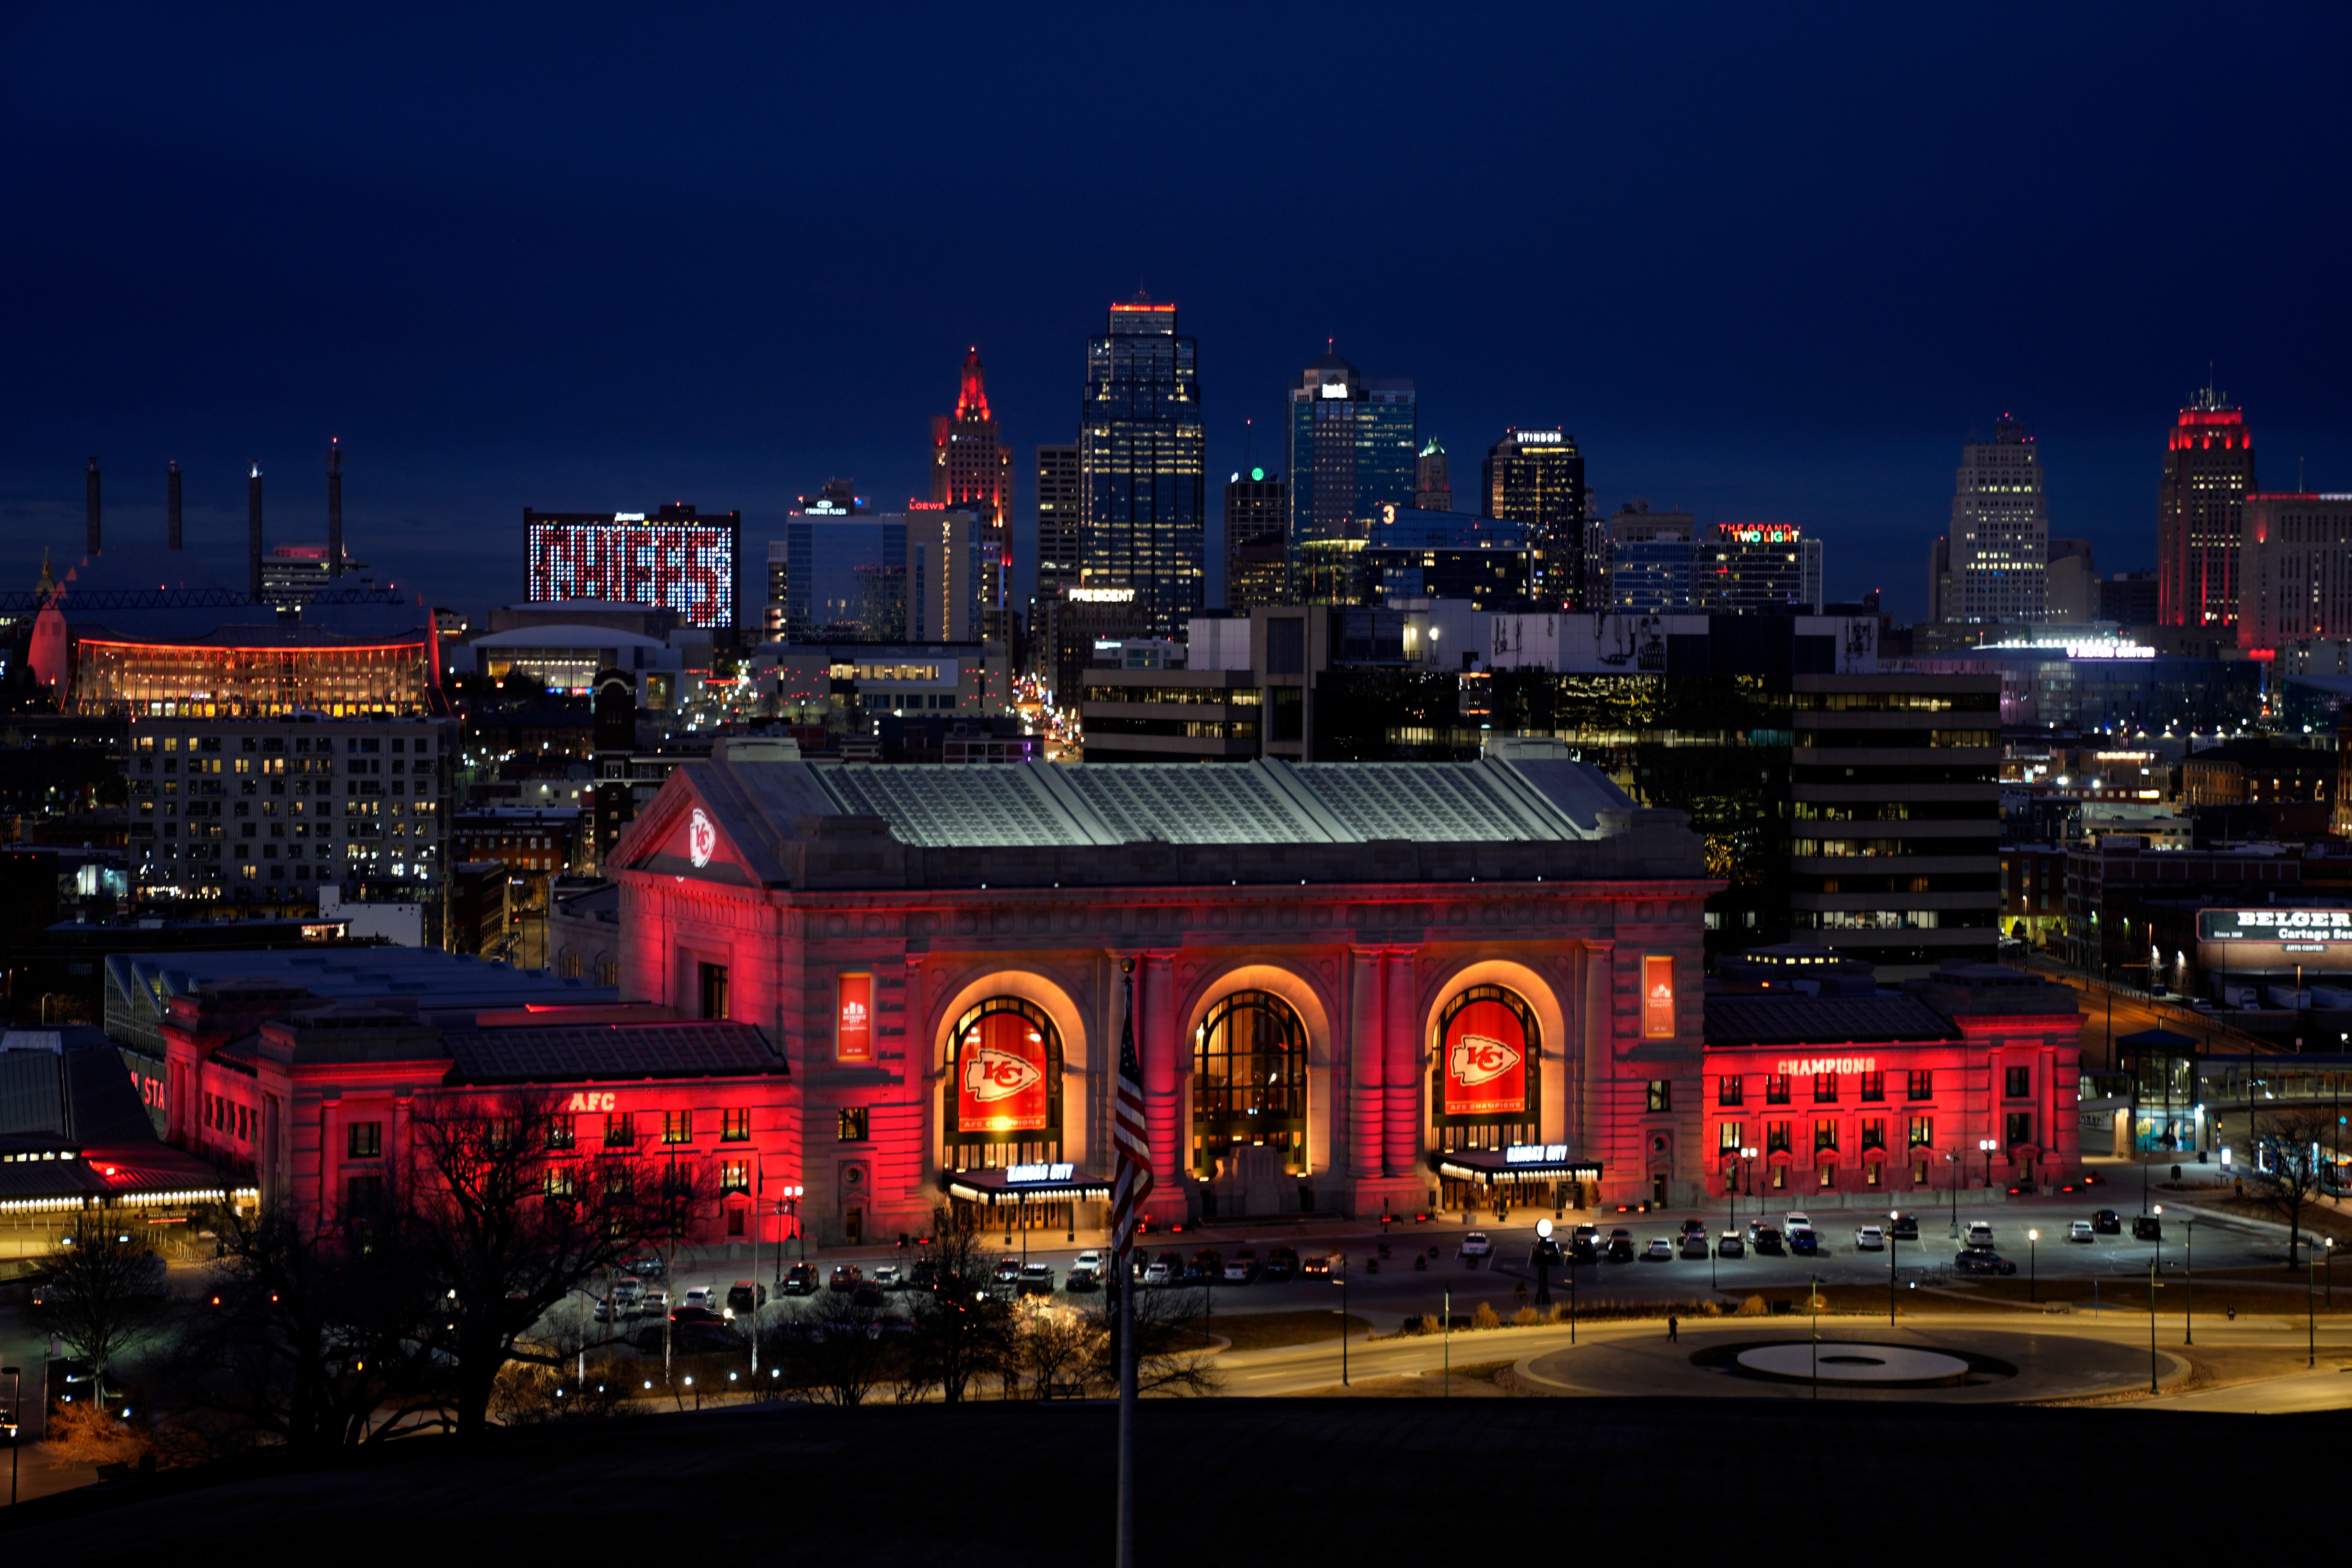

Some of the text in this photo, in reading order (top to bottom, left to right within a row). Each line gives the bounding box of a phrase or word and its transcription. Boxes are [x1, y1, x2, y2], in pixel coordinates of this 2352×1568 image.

[1517, 433, 1561, 442] STINSON
[1383, 505, 1394, 525] 3
[1719, 524, 1791, 533] THE GRAND
[1732, 531, 1799, 543] TWO LIGHT
[1070, 589, 1135, 602] PRESIDENT
[696, 822, 709, 856] KC
[2238, 912, 2352, 927] BELGER
[2279, 928, 2330, 941] Cartage
[1467, 1046, 1503, 1072] KC
[1778, 1058, 1875, 1076] CHAMPIONS
[983, 1061, 1022, 1088] KC
[569, 1092, 615, 1111] AFC
[986, 1119, 1041, 1127] CHAMPIONS
[1507, 1145, 1567, 1163] KANSAS CITY
[1008, 1163, 1074, 1182] KANSAS CITY
